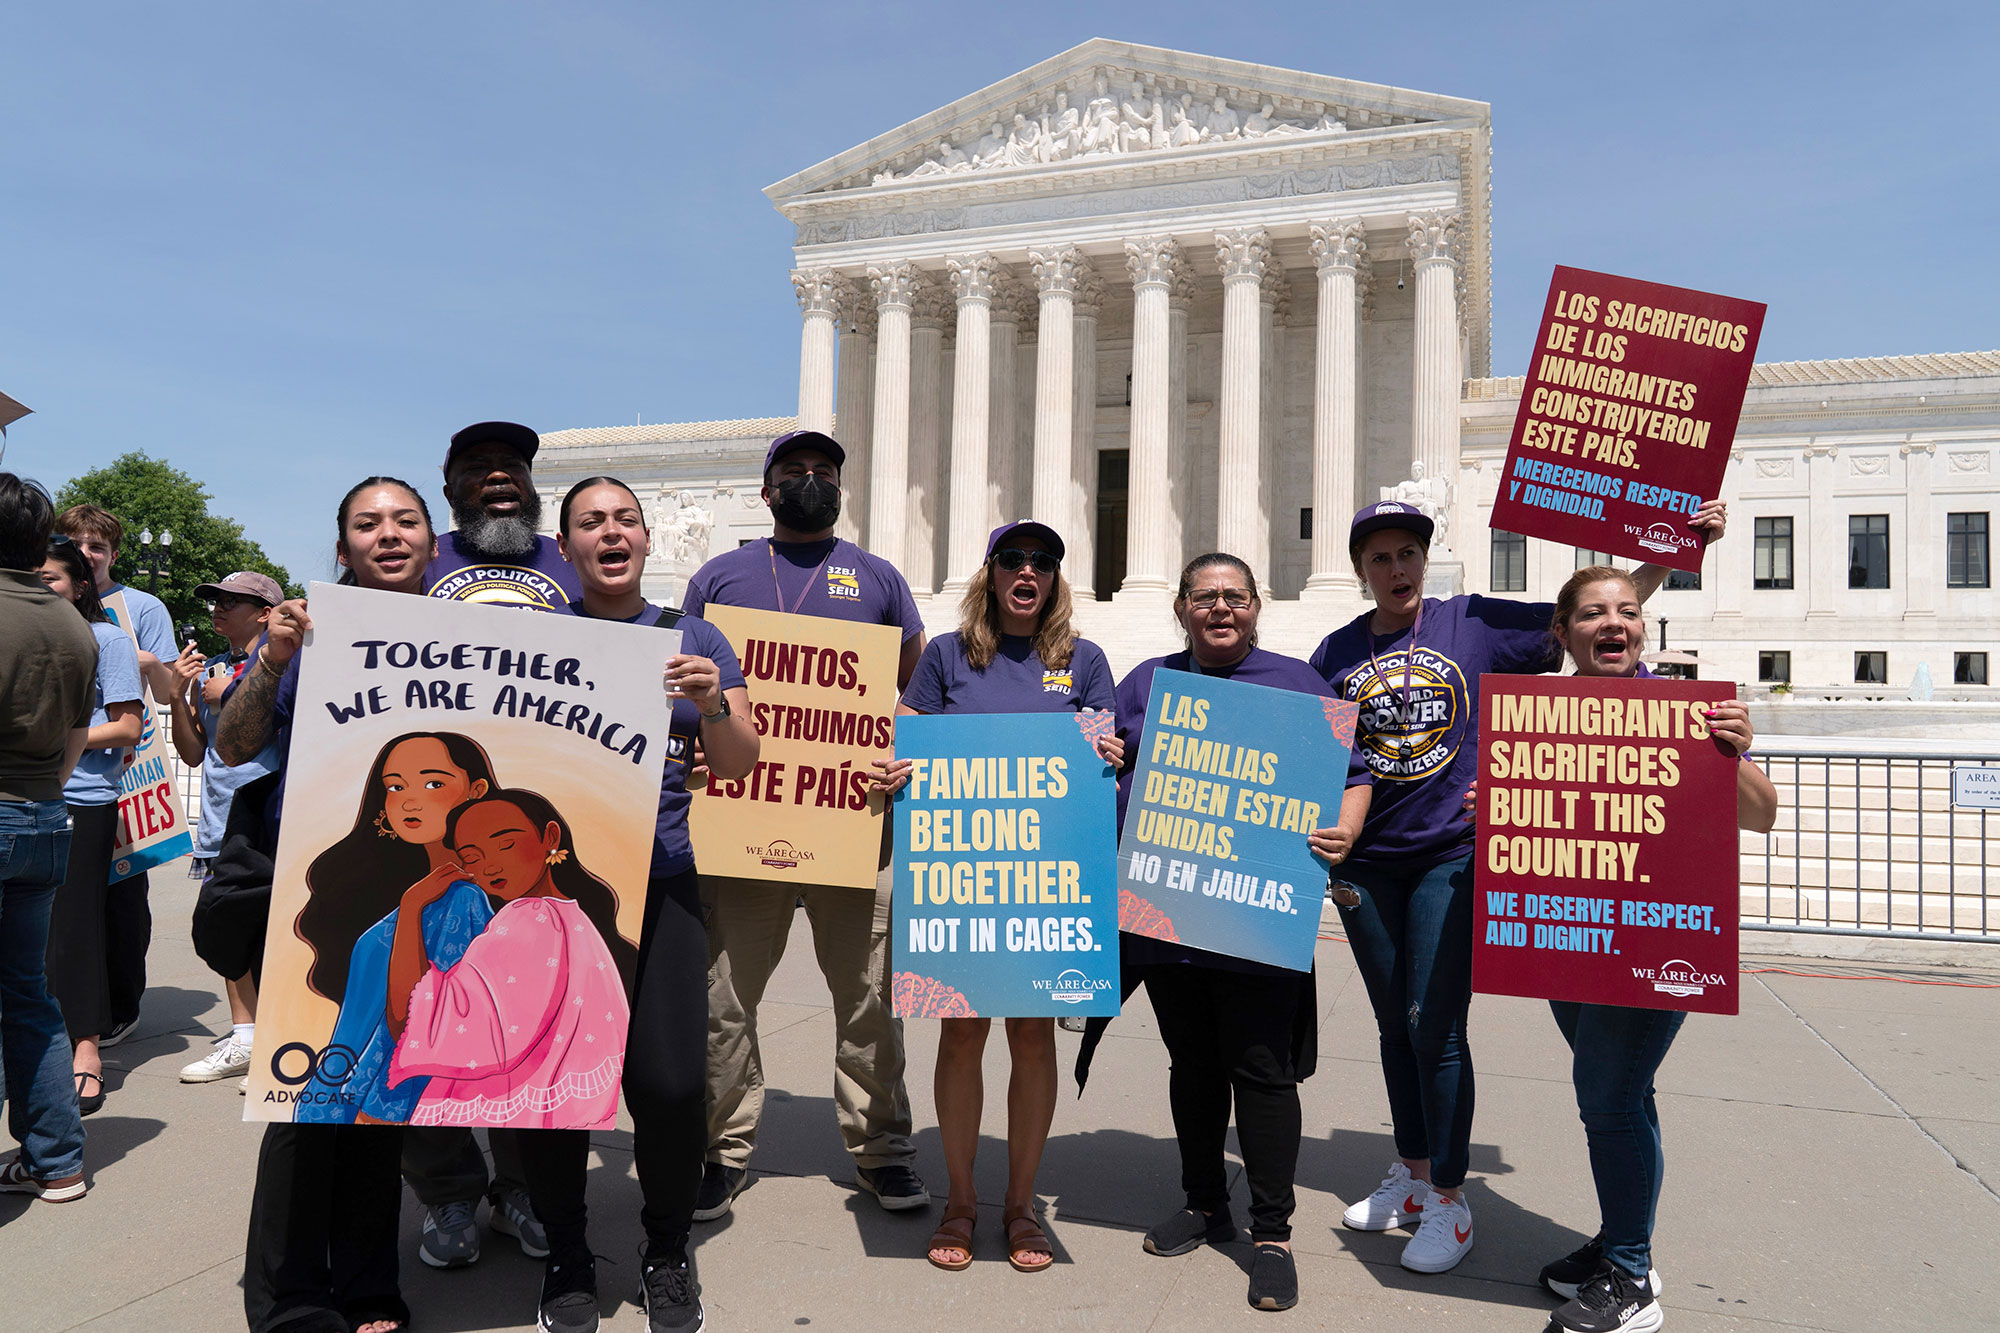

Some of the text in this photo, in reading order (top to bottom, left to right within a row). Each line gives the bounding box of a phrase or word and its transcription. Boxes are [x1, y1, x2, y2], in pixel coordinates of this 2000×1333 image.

[980, 185, 1228, 224] EQUAL JUSTICE UNDER LAW
[1546, 322, 1628, 363] DE LOS
[1554, 290, 1748, 353] LOS SACRIFICIOS
[1537, 354, 1697, 412] INMIGRANTES
[1530, 387, 1711, 449] CONSTRUYERON
[1521, 418, 1640, 470] ESTE PAÍS.
[1509, 480, 1607, 522] Y DIGNIDAD.
[1513, 457, 1701, 515] MERECEMOS RESPETO
[1624, 524, 1643, 536] WE
[1644, 529, 1669, 542] ARE
[1669, 534, 1698, 549] CASA
[436, 569, 556, 600] 32BJ POLITICAL
[827, 565, 856, 576] 32BJ
[828, 586, 860, 597] SEIU
[460, 584, 486, 599] BUILDING
[517, 587, 537, 600] POWER
[351, 639, 596, 692] TOGETHER,
[737, 638, 867, 697] JUNTOS,
[1043, 670, 1073, 678] 32BJ
[1348, 666, 1375, 696] 32BJ
[1379, 653, 1451, 679] POLTICAL
[1413, 669, 1434, 681] POWER
[1043, 684, 1072, 695] SEIU
[1369, 696, 1392, 709] WE
[325, 679, 648, 765] WE ARE AMERICA
[749, 702, 891, 749] STRUIMOS
[1159, 692, 1210, 732] LAS
[1360, 700, 1447, 731] POWER
[911, 757, 1069, 800] FAMILIES
[1151, 731, 1279, 786] FAMILIAS
[1362, 743, 1449, 774] ORGANIZERS
[1489, 740, 1681, 787] SACRIFICES
[1966, 774, 1997, 782] AREA
[115, 781, 174, 849] TIES
[1143, 770, 1321, 835] DEBEN ESTAR
[1489, 787, 1666, 835] BUILT THIS
[910, 808, 1040, 852] BELONG
[1136, 809, 1239, 862] UNIDAS.
[746, 846, 763, 855] WE
[765, 848, 787, 857] ARE
[788, 850, 815, 860] CASA
[1487, 834, 1651, 883] COUNTRY.
[909, 861, 1091, 905] TOGETHER.
[1128, 851, 1298, 915] NO EN JAULAS.
[1486, 891, 1721, 935] WE DESERVE RESPECT,
[909, 917, 1102, 953] NOT IN CAGES.
[1485, 920, 1621, 955] AND DIGNITY.
[1032, 979, 1112, 990] WE ARE CASA
[1632, 968, 1655, 979] WE
[1658, 970, 1688, 982] ARE
[1690, 972, 1727, 985] CASA
[264, 1090, 356, 1105] ADVOCATE
